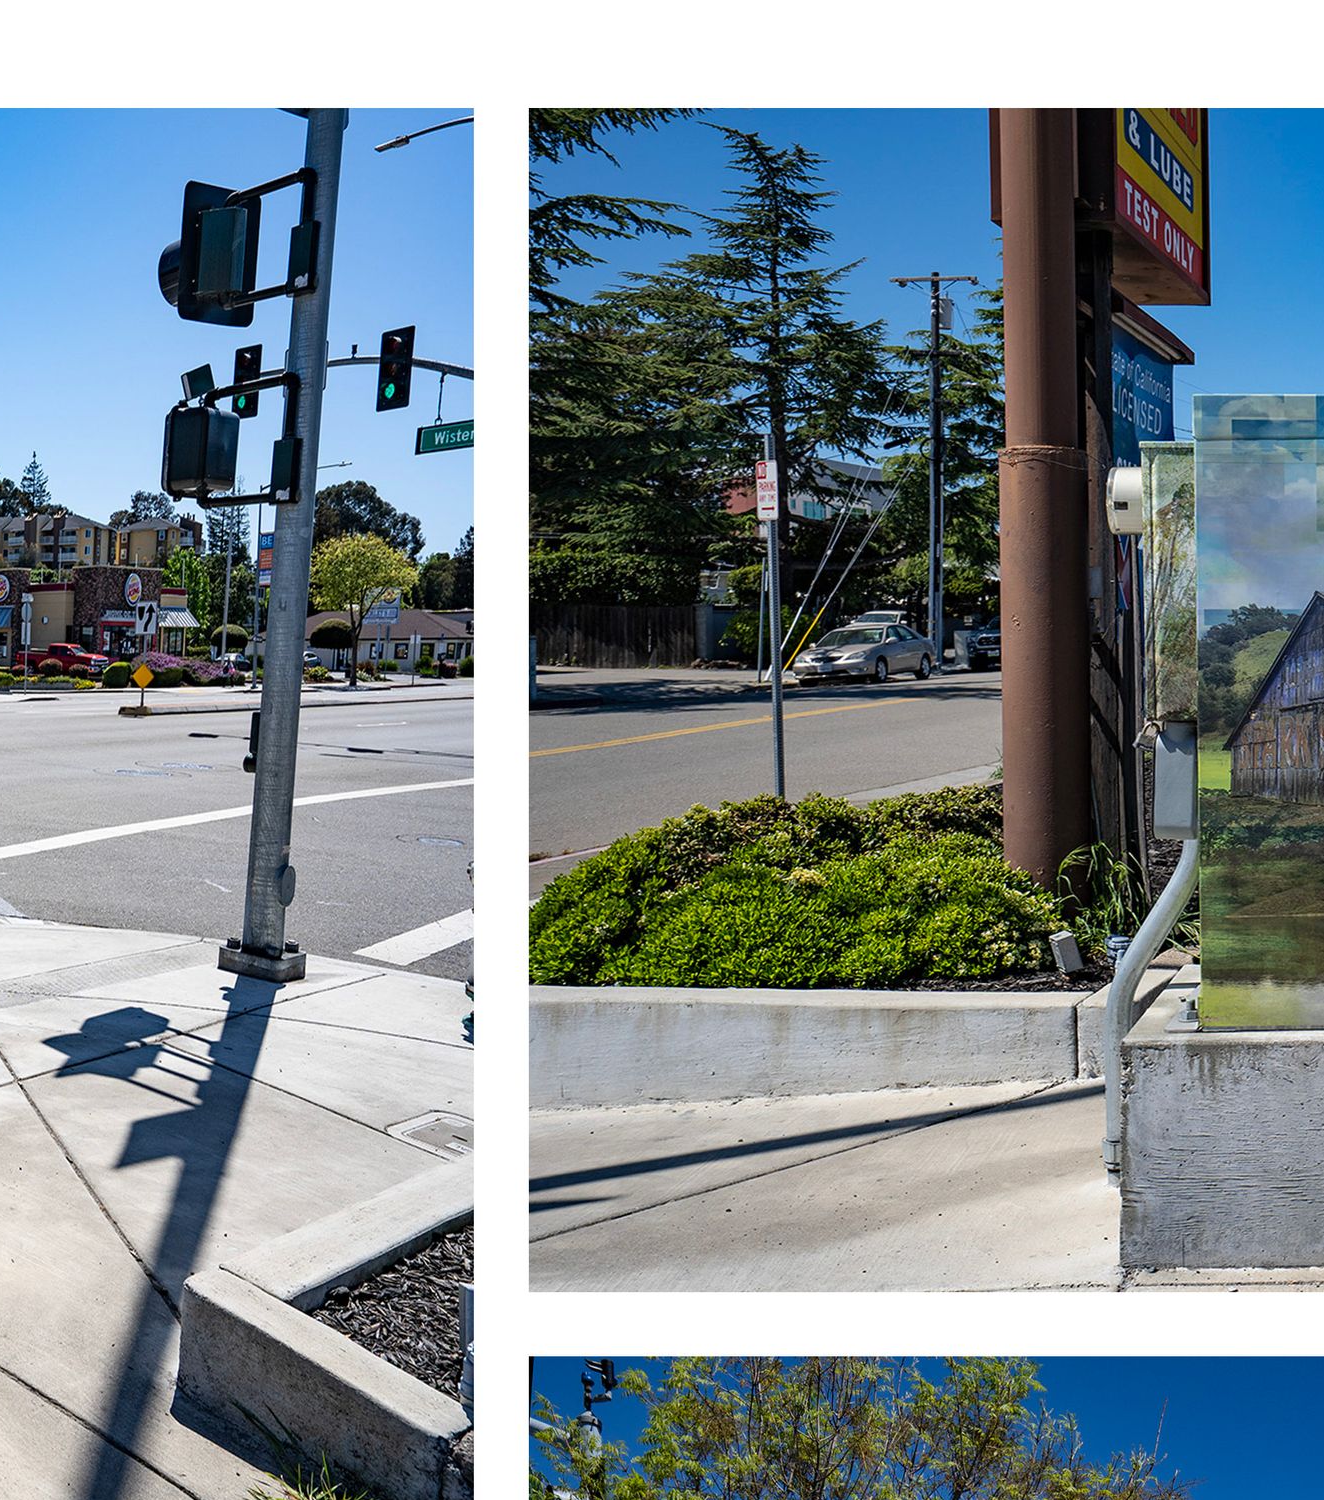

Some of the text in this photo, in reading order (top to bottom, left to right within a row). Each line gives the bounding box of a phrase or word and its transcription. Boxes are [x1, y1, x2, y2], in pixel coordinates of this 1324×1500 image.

[1128, 110, 1141, 150] &
[1150, 132, 1192, 208] LUBE
[1124, 179, 1195, 273] TEST ONLY
[1112, 382, 1162, 435] LICENSED
[1134, 363, 1171, 403] California
